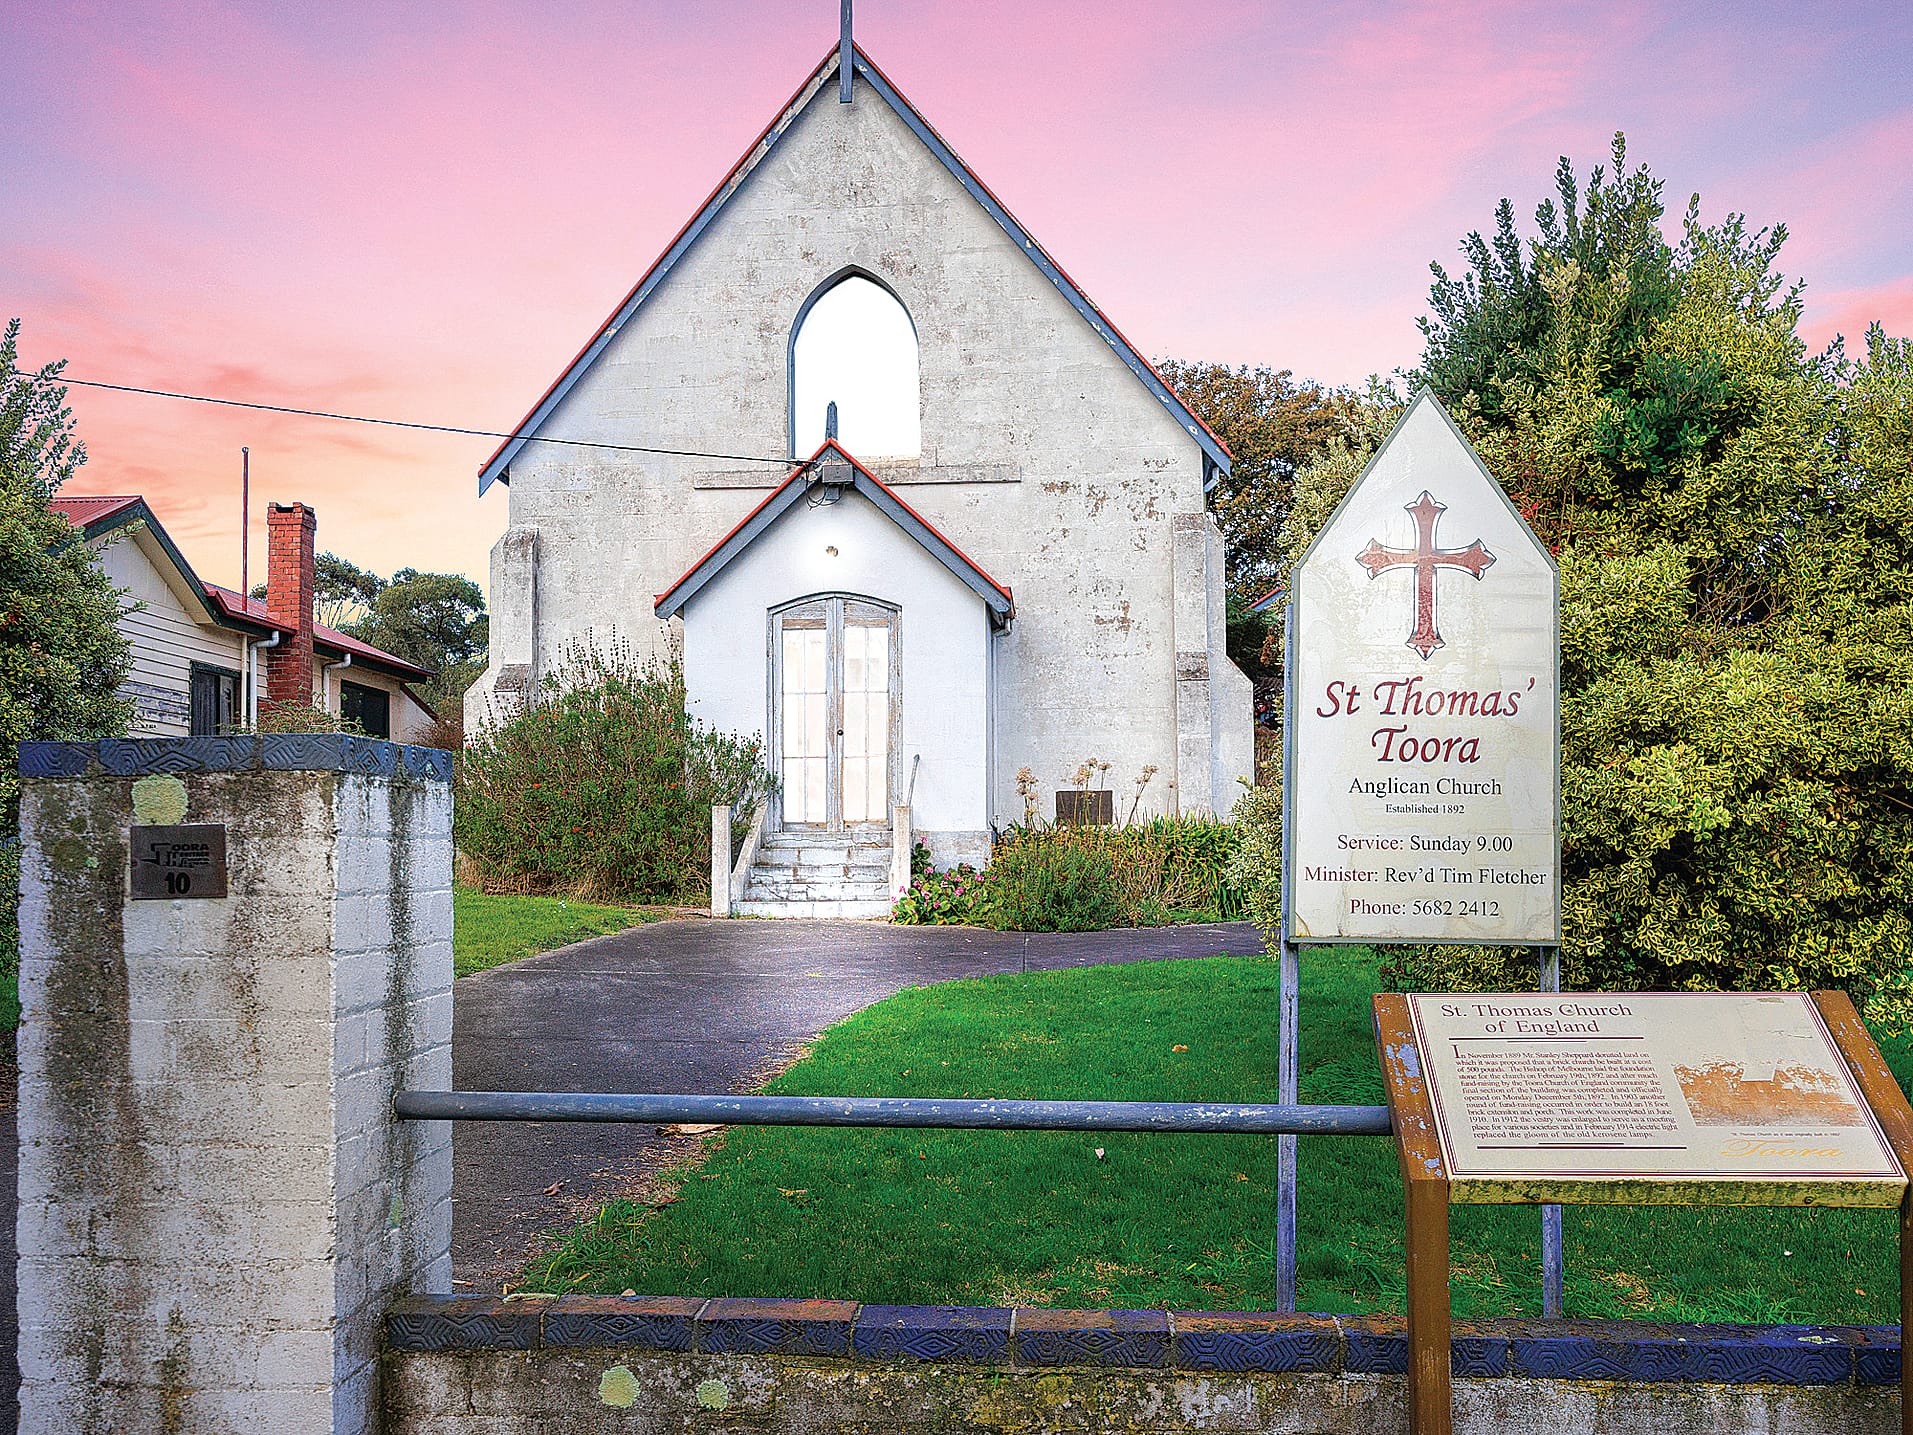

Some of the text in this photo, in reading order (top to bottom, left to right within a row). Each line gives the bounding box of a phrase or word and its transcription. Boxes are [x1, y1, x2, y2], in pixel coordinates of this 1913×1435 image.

[1317, 676, 1535, 718] St Thomas'
[1371, 725, 1480, 763] Toora
[1348, 778, 1501, 798] Anglican Church
[1385, 804, 1465, 814] Established 1892
[1337, 834, 1512, 855] Service: Sunday 9.00
[1305, 867, 1378, 882] Minister:
[1440, 868, 1473, 883] Tim
[1479, 869, 1546, 884] Fletcher
[165, 872, 191, 894] 10
[1350, 900, 1499, 916] Phone: 5682 2412
[1441, 1004, 1632, 1017] St. Thomas Church
[1485, 1020, 1600, 1036] of England
[1452, 1044, 1466, 1058] In
[1536, 1051, 1560, 1060] Stanley
[1562, 1051, 1594, 1060] Sheppard
[1500, 1058, 1530, 1067] proposed
[1524, 1065, 1547, 1074] Bishop
[1538, 1072, 1568, 1081] February
[1461, 1079, 1500, 1088] fund-raising
[1502, 1079, 1509, 1088] by
[1580, 1079, 1608, 1088] England
[1610, 1078, 1647, 1087] community
[1530, 1086, 1559, 1095] building
[1577, 1086, 1614, 1095] completed
[1631, 1086, 1663, 1095] officially
[1464, 1093, 1489, 1102] opened
[1503, 1093, 1532, 1102] Monday
[1499, 1101, 1542, 1110] fund-raising
[1611, 1108, 1646, 1117] completed
[1533, 1116, 1553, 1125] vestry
[1571, 1115, 1601, 1124] enlarged
[1647, 1115, 1675, 1124] meeting
[1472, 1123, 1490, 1132] place
[1584, 1123, 1615, 1132] February
[1661, 1123, 1678, 1132] light
[1474, 1131, 1506, 1140] replaced
[1524, 1131, 1548, 1140] gloom
[1721, 1139, 1843, 1157] Toora
